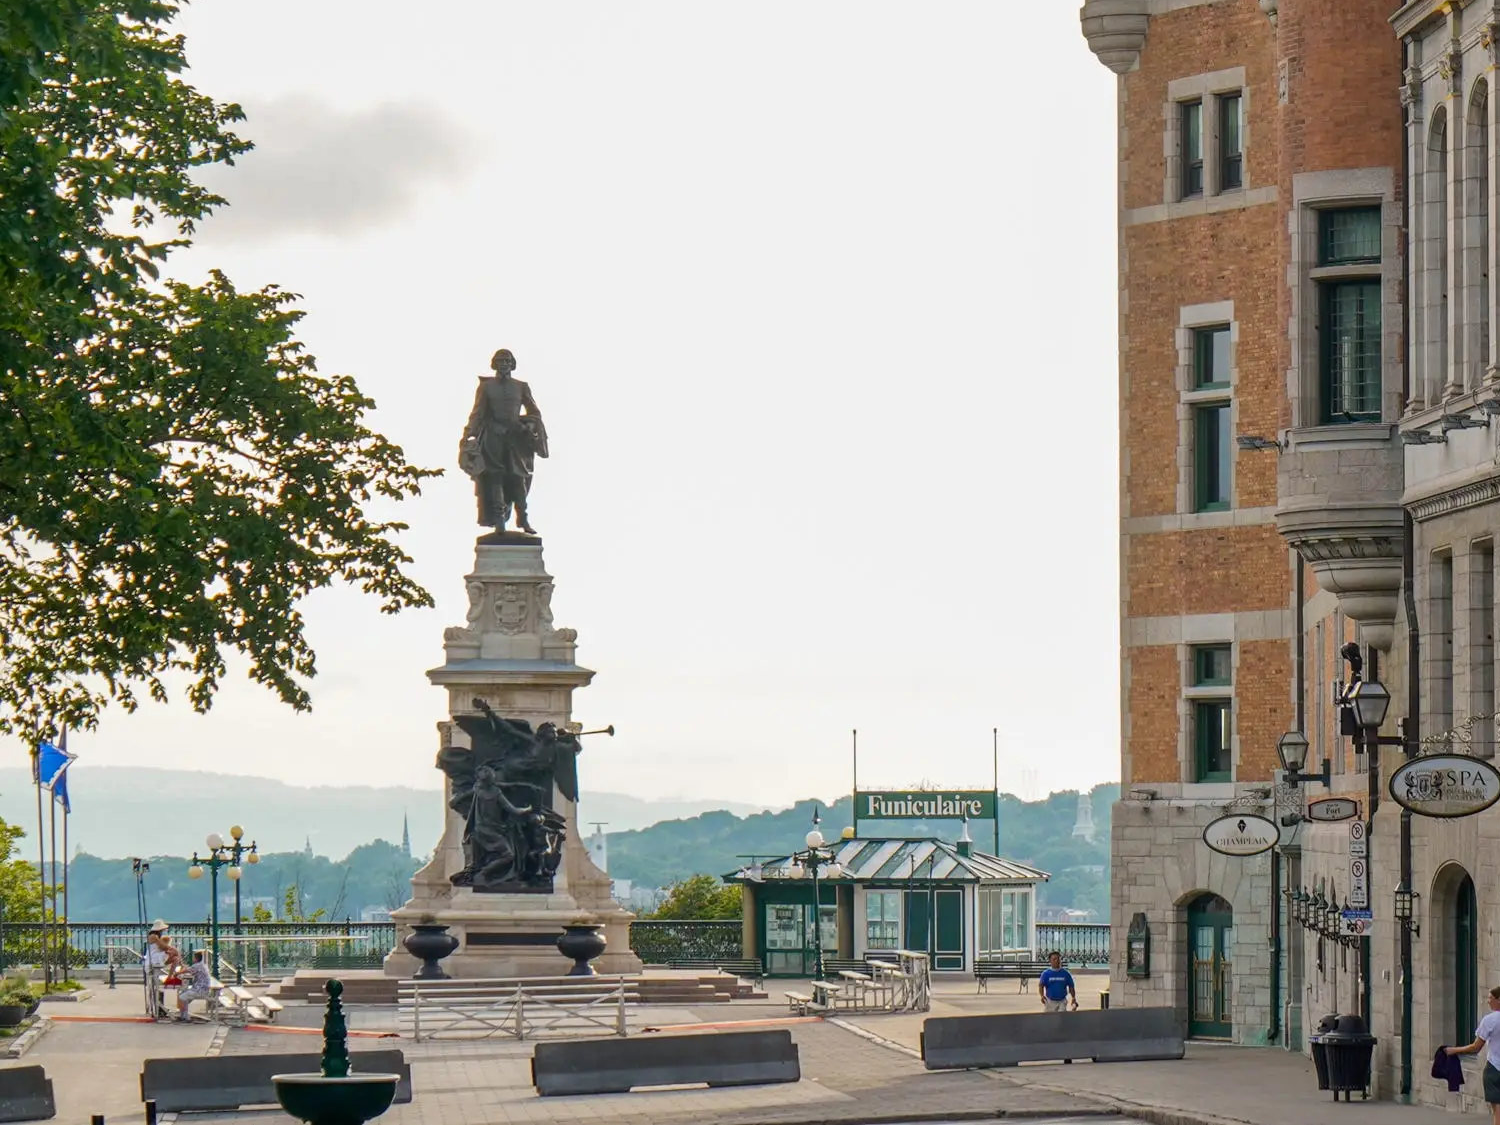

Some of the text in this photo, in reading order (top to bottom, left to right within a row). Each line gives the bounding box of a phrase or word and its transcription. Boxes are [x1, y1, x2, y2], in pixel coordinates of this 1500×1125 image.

[1446, 770, 1487, 786] SPA
[867, 795, 982, 816] Funiculaire
[1216, 836, 1269, 846] CHAMPLAIN
